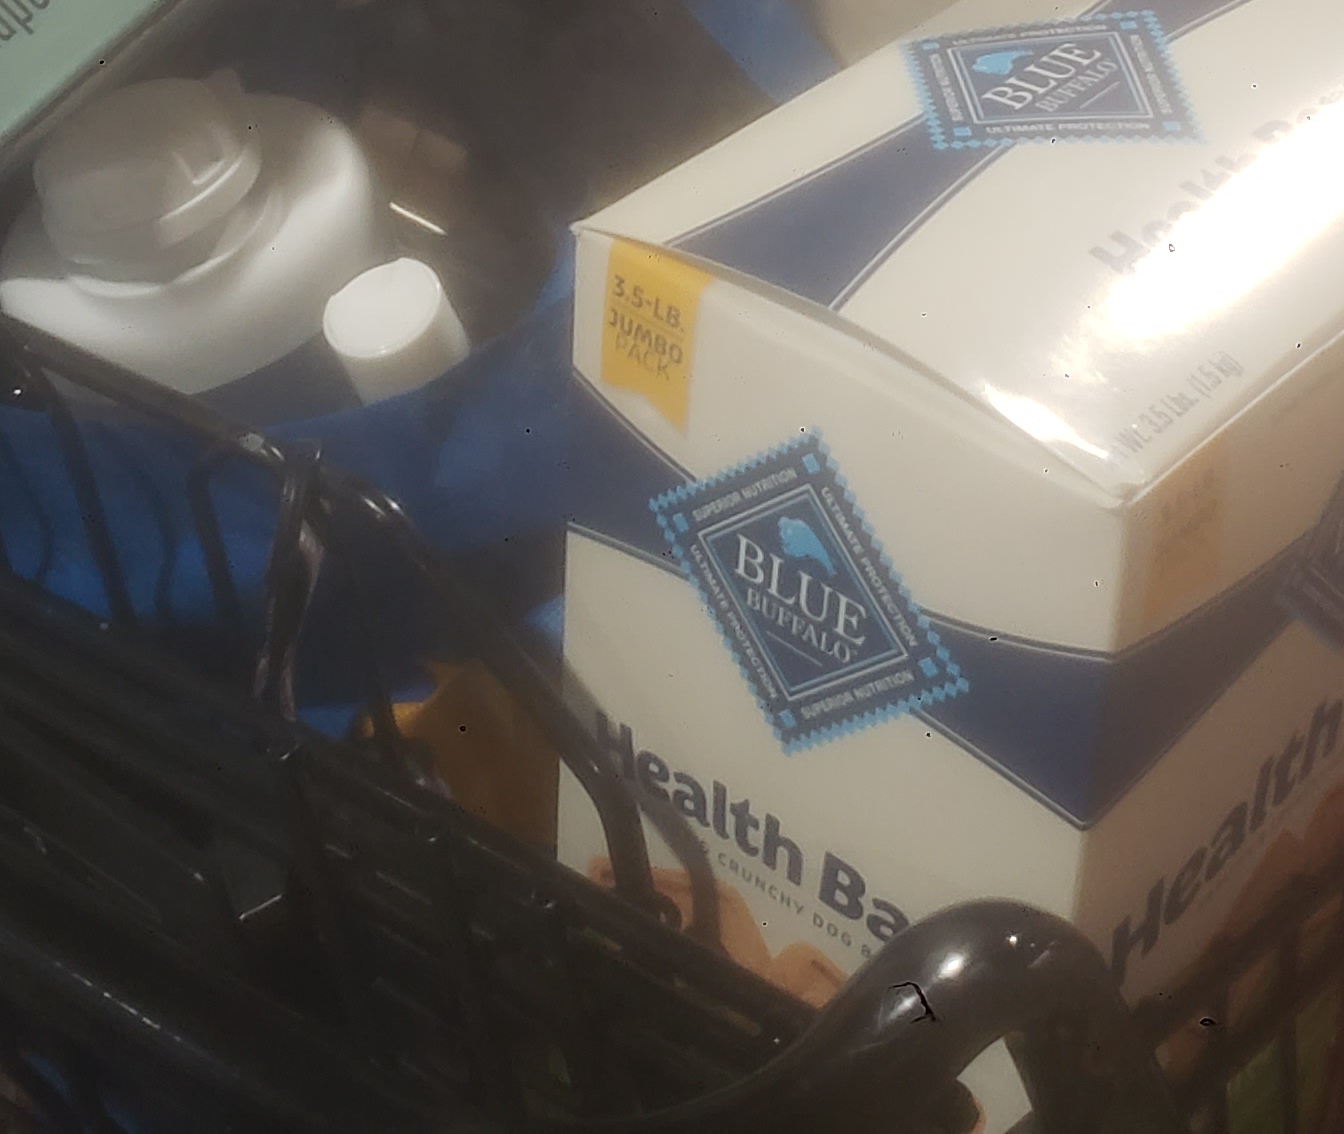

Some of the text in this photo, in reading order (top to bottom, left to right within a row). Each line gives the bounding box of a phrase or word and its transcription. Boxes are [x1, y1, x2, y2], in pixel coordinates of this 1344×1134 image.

[983, 42, 1102, 111] BLUE
[1035, 58, 1120, 113] BUFFALO
[984, 122, 1056, 135] ULTIMATE
[609, 308, 683, 364] JUMBO
[611, 273, 685, 333] 3.5-LB.
[615, 331, 670, 381] PACK
[734, 533, 867, 646] BLUE
[821, 486, 919, 648] ULTIMATE PROTECTION
[746, 586, 855, 664] BUFFALO
[598, 713, 911, 944] Health Ba
[1111, 696, 1343, 979] Health
[717, 851, 853, 948] CRUNCHY DOG
